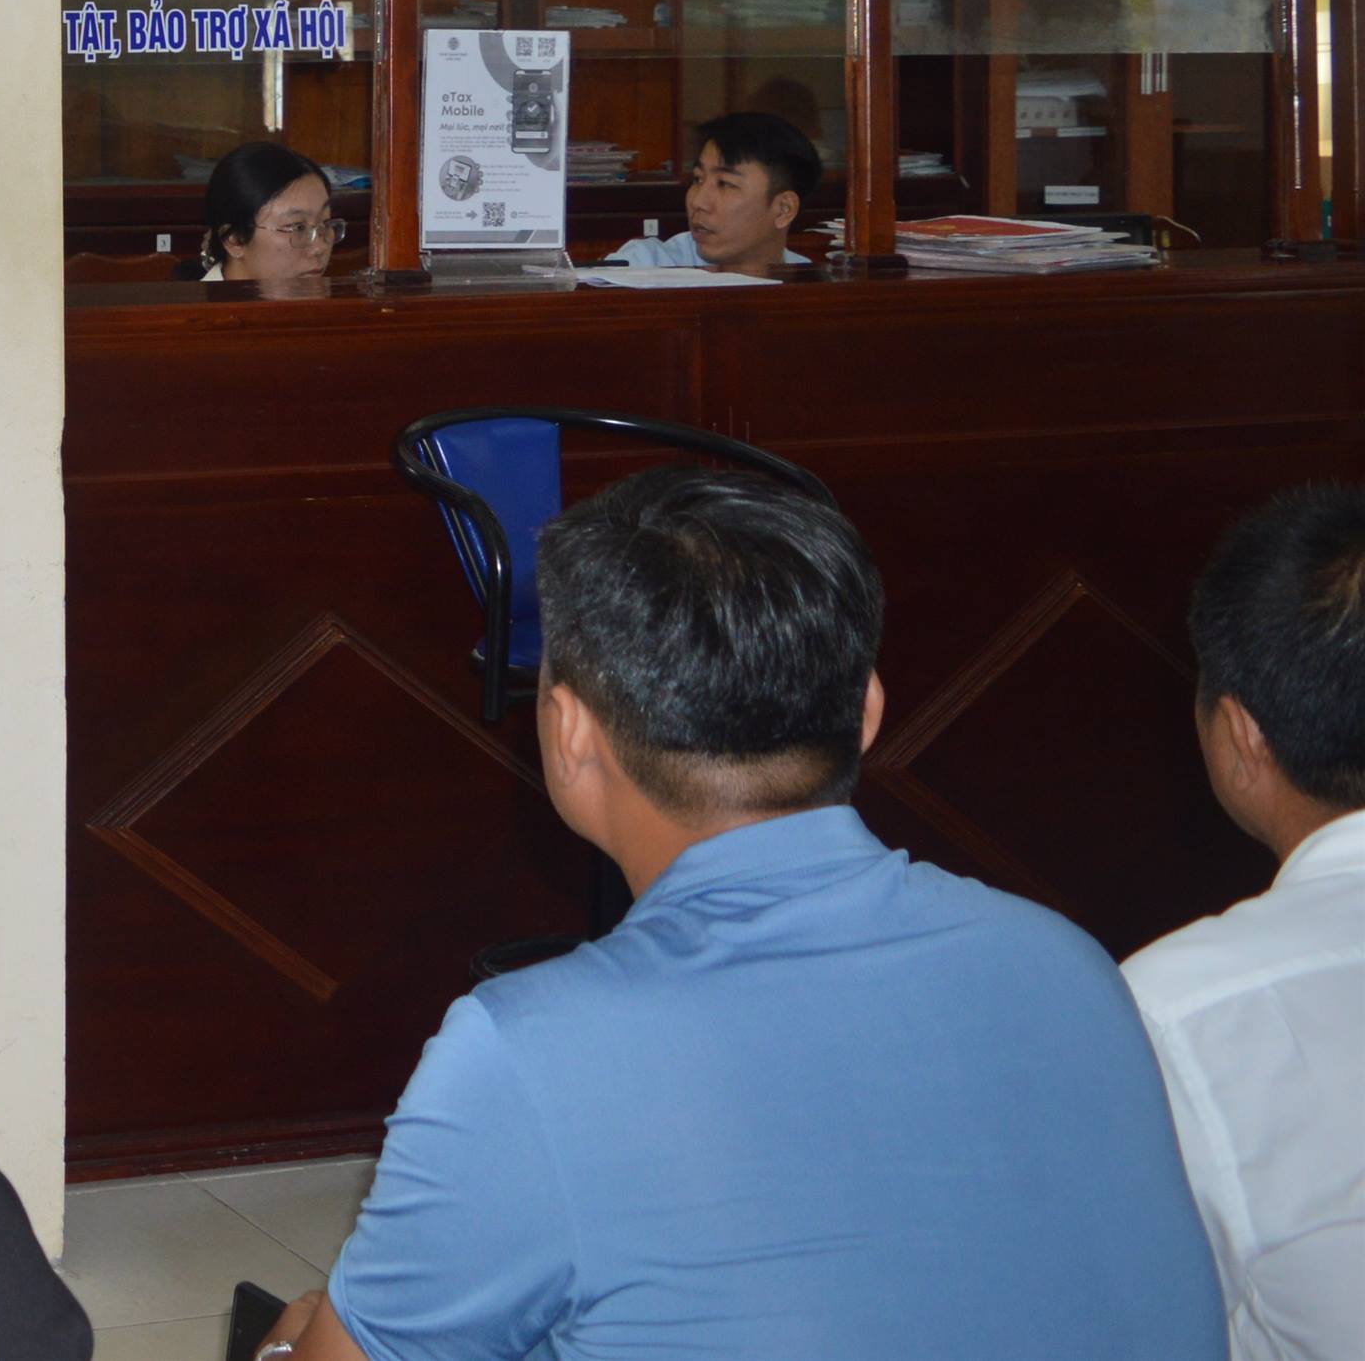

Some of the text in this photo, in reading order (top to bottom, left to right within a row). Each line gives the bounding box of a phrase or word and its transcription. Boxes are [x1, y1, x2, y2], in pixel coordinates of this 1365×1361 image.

[63, 1, 122, 63] TẬT,
[191, 4, 249, 61] TRỢ
[298, 0, 347, 59] HỘI
[441, 91, 473, 103] eTax
[441, 105, 485, 116] Mobile
